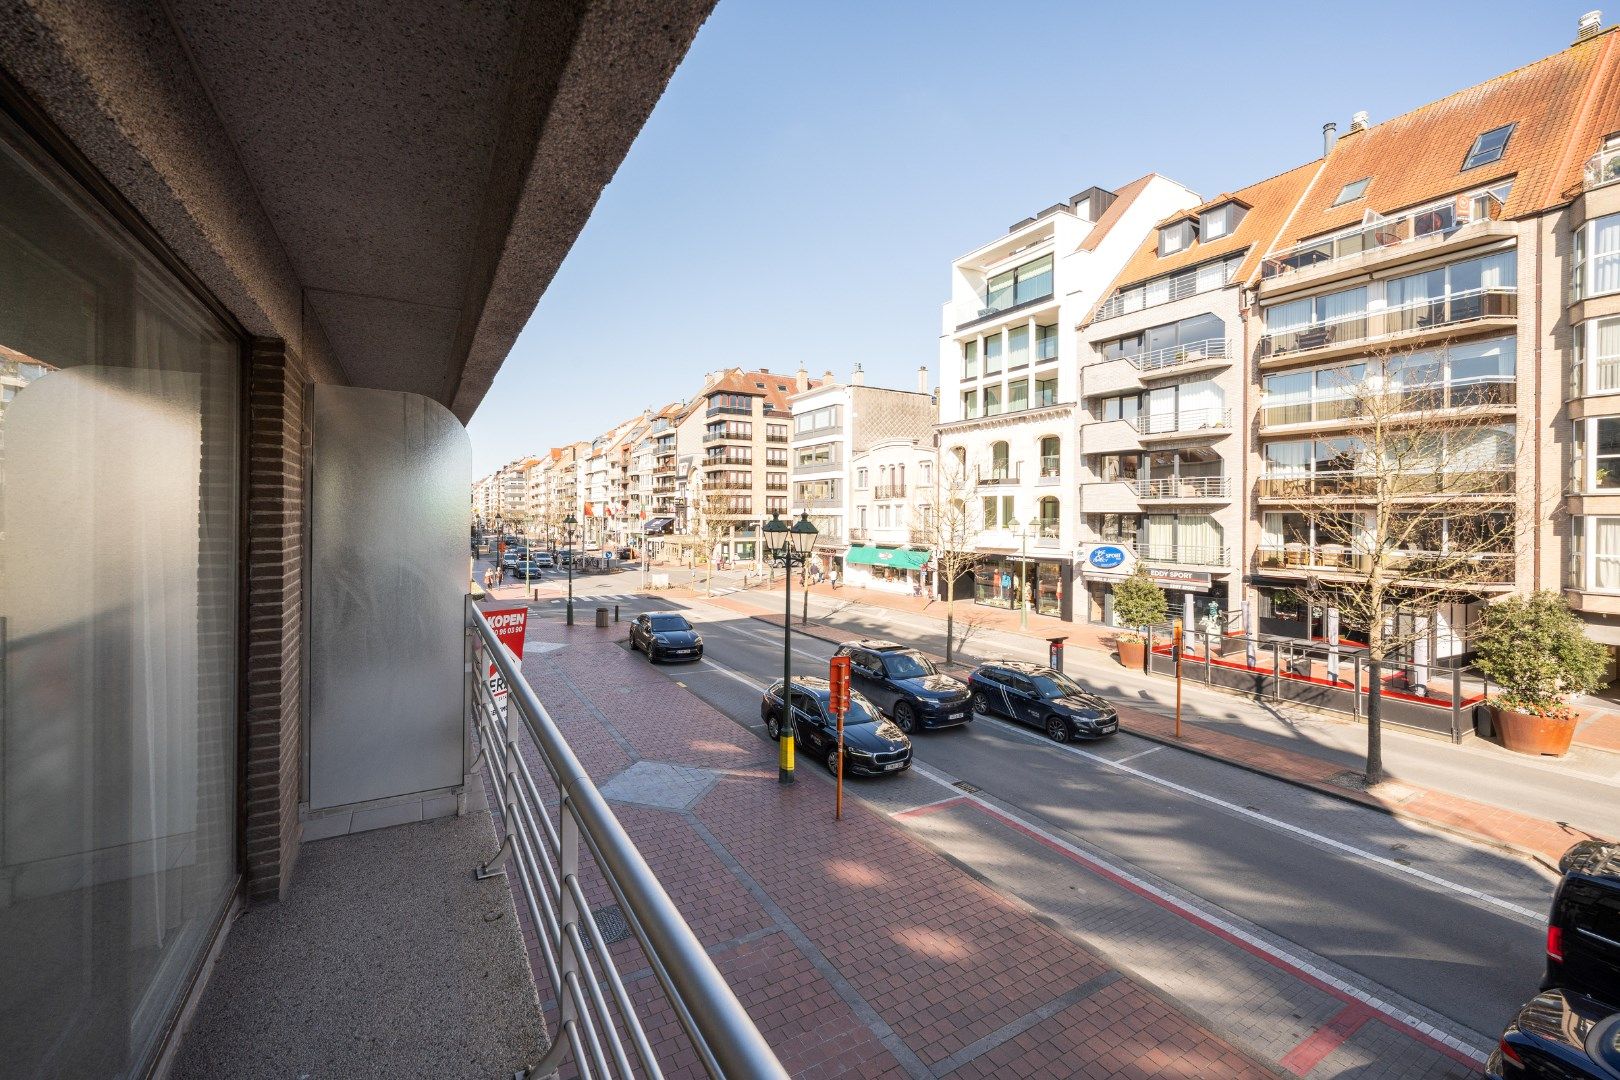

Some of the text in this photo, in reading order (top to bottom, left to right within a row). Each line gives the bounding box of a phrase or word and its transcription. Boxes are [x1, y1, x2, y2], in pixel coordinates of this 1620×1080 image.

[1169, 571, 1193, 579] SPORT
[487, 613, 525, 629] KOPEN
[489, 677, 506, 693] ER
